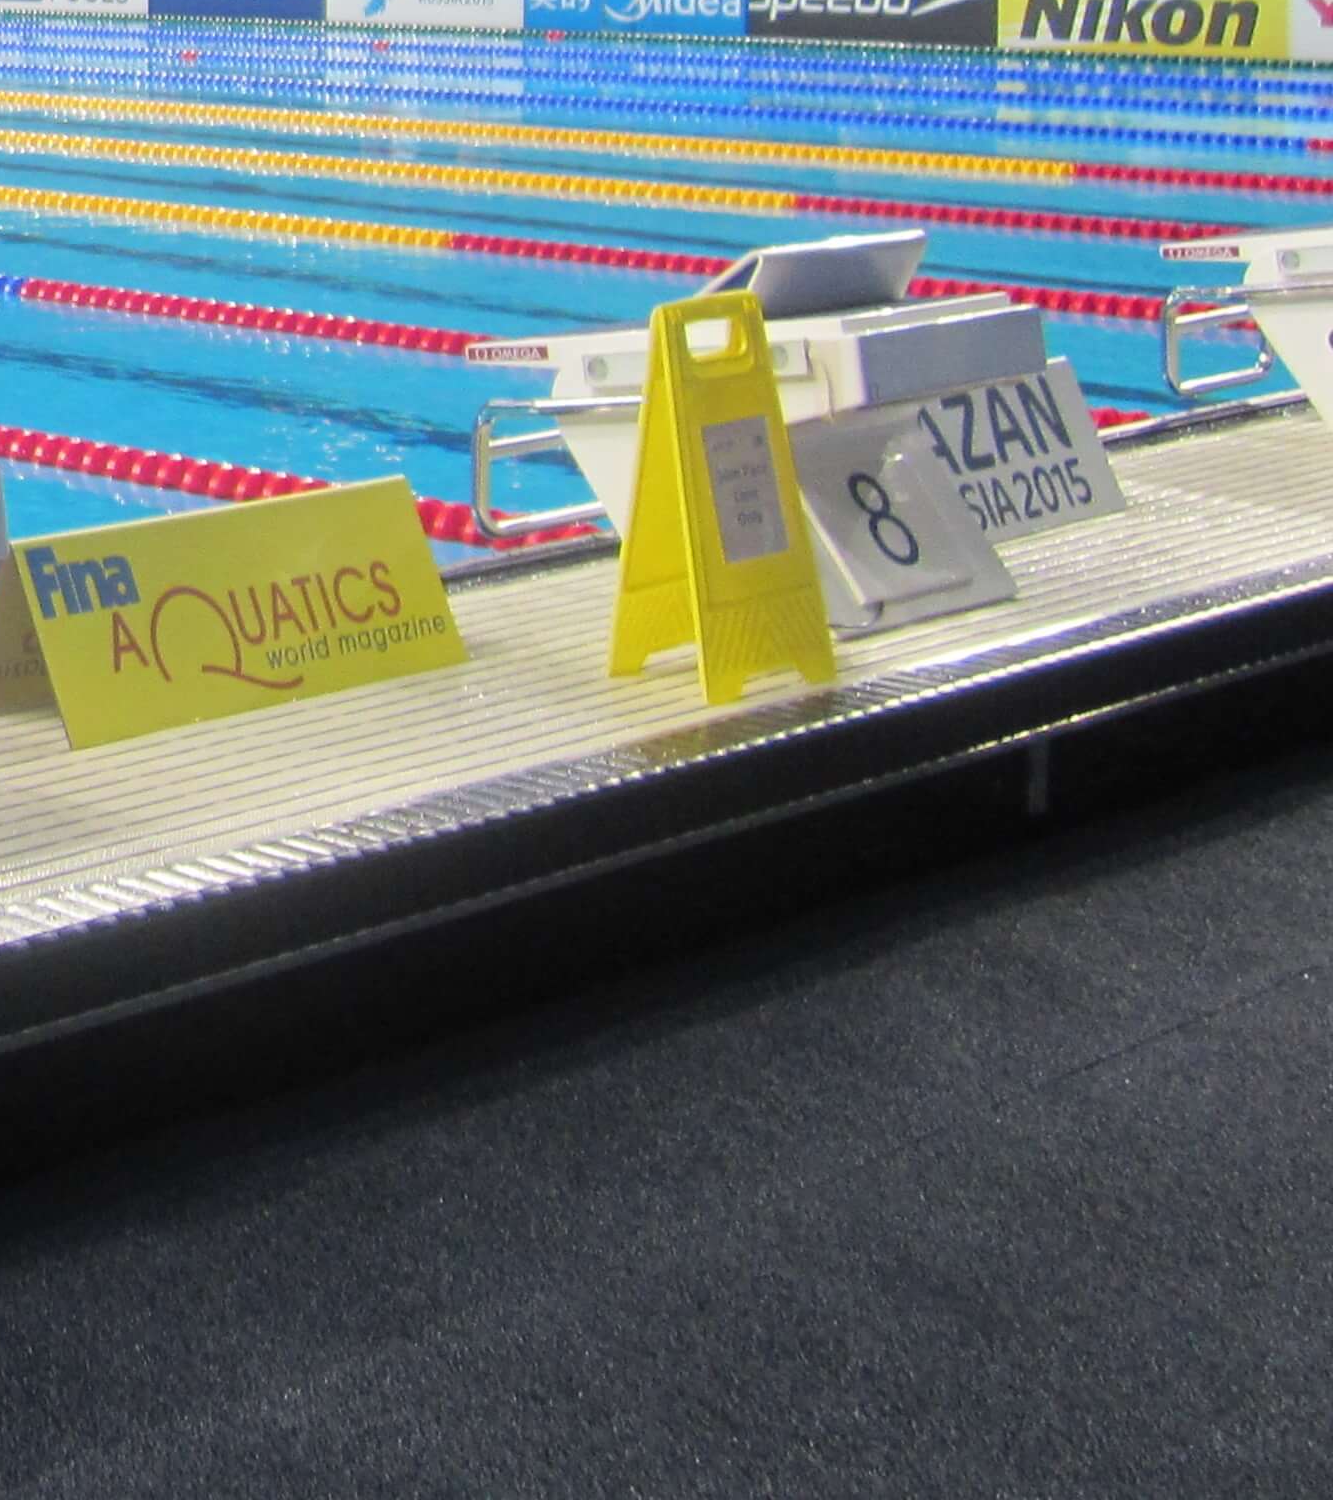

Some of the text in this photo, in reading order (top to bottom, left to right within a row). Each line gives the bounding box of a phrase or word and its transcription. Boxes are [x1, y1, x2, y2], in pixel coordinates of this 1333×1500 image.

[492, 347, 541, 360] OMEGA
[918, 374, 1073, 475] AZAN
[848, 472, 919, 566] 8
[959, 457, 1092, 531] SIA 2015
[111, 561, 403, 689] AQUATICS
[266, 612, 446, 670] world magazine
